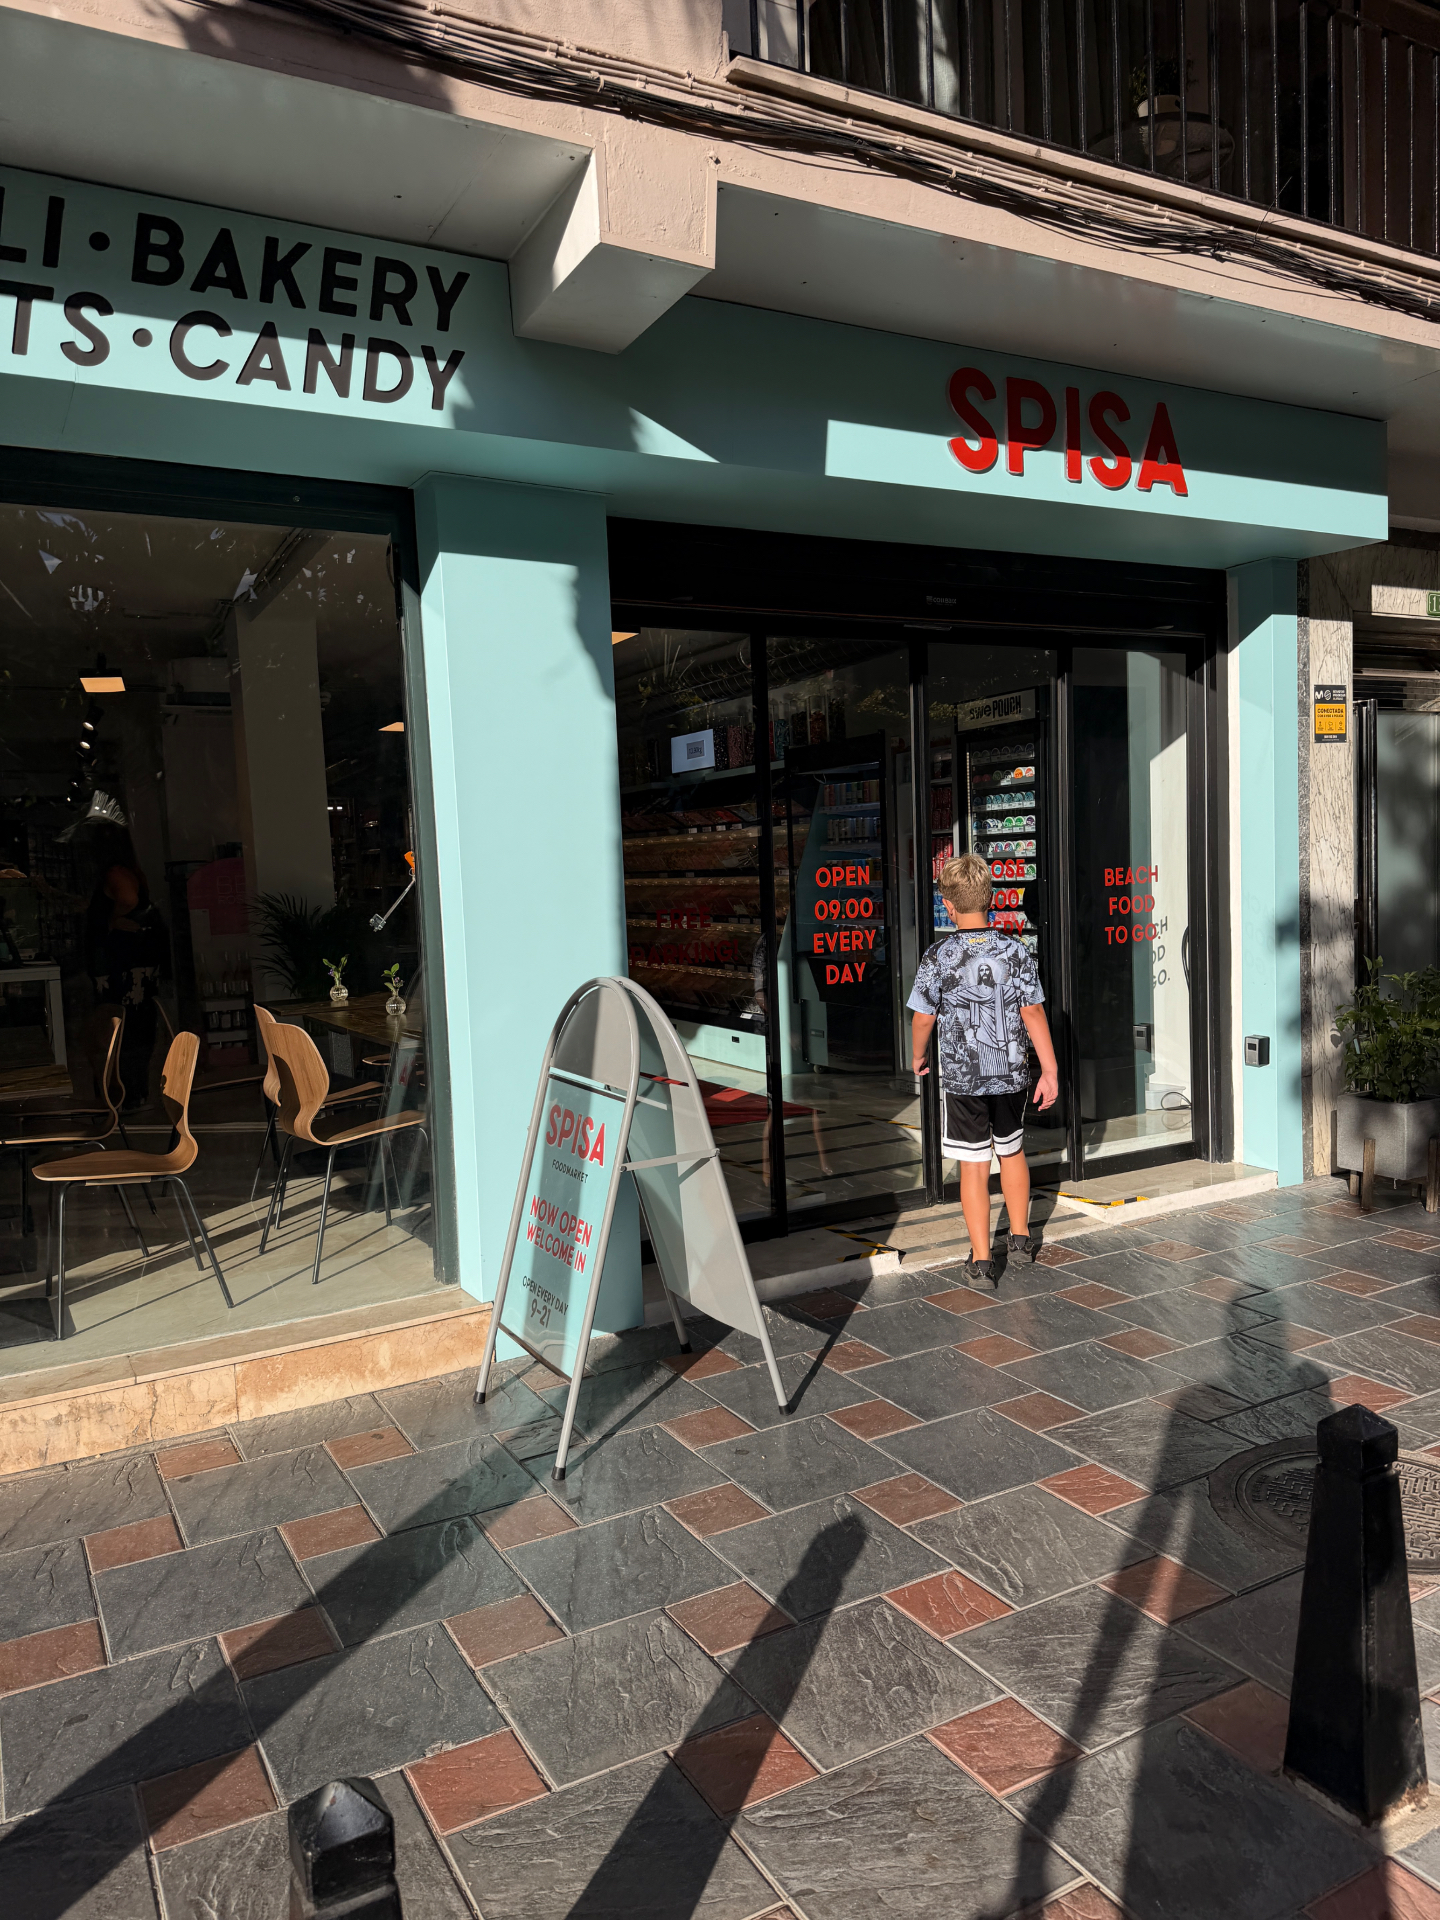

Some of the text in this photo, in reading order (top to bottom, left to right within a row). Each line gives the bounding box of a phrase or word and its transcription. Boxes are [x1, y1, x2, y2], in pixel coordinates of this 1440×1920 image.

[131, 212, 470, 332] BAKERY
[169, 310, 465, 411] CANDY
[946, 367, 1189, 497] SPISA
[815, 865, 870, 887] OPEN
[991, 859, 1026, 879] OSE
[1104, 865, 1158, 887] BEACH
[814, 897, 873, 920] 09.00
[1108, 894, 1155, 916] FOOD
[655, 906, 711, 930] FREE
[813, 929, 876, 953] EVERY
[1104, 923, 1161, 945] TO GO.
[629, 938, 739, 967] PARKING!
[826, 962, 866, 985] DAY
[545, 1104, 606, 1168] SPISA
[551, 1159, 589, 1184] FOODMARKET
[530, 1194, 593, 1248] NOW OPEN
[526, 1221, 587, 1274] WELCOME IN
[522, 1275, 569, 1316] OPEN EVERY DAY
[530, 1298, 552, 1329] 9-21
